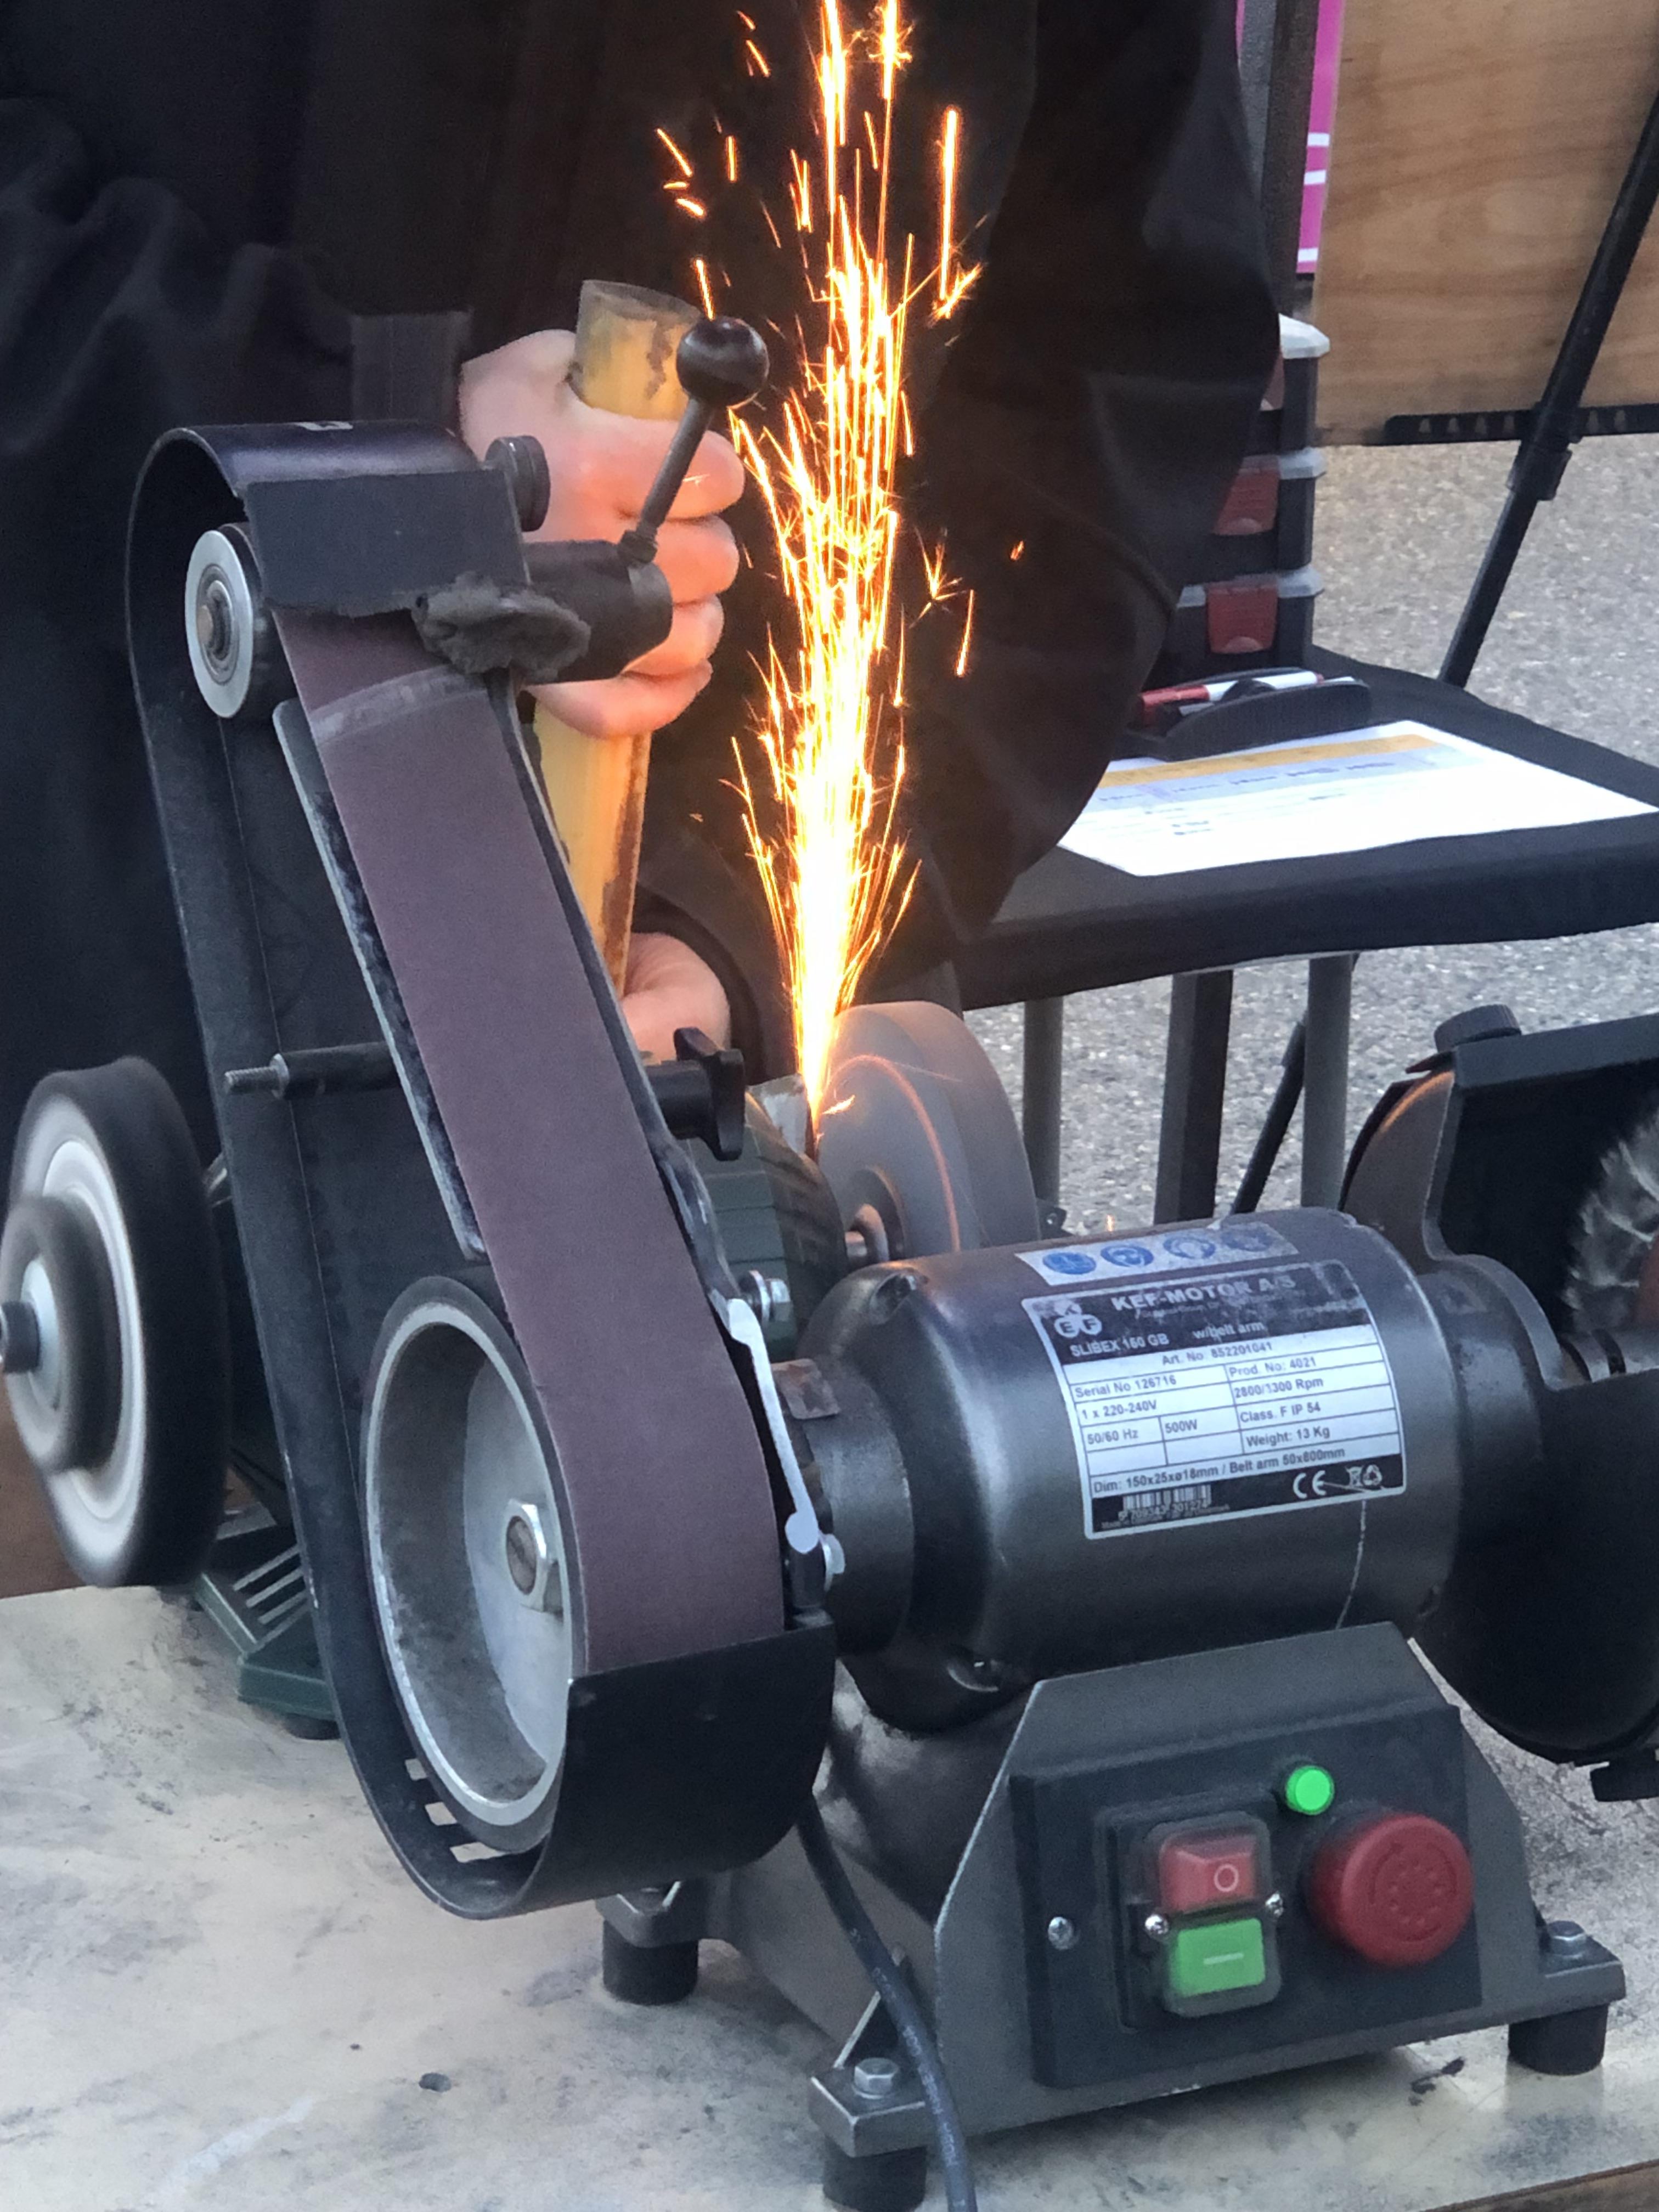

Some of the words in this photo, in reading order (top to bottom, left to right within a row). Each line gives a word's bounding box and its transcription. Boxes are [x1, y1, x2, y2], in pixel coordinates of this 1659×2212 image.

[1111, 1282, 1252, 1311] KEF-MOTOR
[1258, 1274, 1296, 1291] A/S
[1147, 1333, 1170, 1346] GB
[1238, 1322, 1265, 1334] arm
[1211, 1342, 1272, 1359] 852201041
[1290, 1356, 1317, 1369] 4021
[1075, 1383, 1111, 1398] Serial
[1135, 1374, 1177, 1390] 126716
[1234, 1380, 1293, 1399] 2800/1300
[1295, 1378, 1324, 1391] Rpm
[1082, 1409, 1088, 1420] 1
[1092, 1410, 1100, 1419] x
[1103, 1400, 1157, 1417] 220-240V
[1280, 1406, 1287, 1417] F
[1291, 1403, 1303, 1415] IP
[1307, 1402, 1321, 1413] 54
[1087, 1430, 1119, 1445] 50/60
[1122, 1428, 1138, 1440] Hz
[1165, 1419, 1198, 1434] 500W
[1246, 1432, 1293, 1447] Weight:
[1296, 1427, 1310, 1440] 13
[1313, 1426, 1330, 1439] Kg
[1093, 1480, 1122, 1494] Dim:
[1229, 1459, 1254, 1474] Belt
[1256, 1456, 1279, 1469] arm
